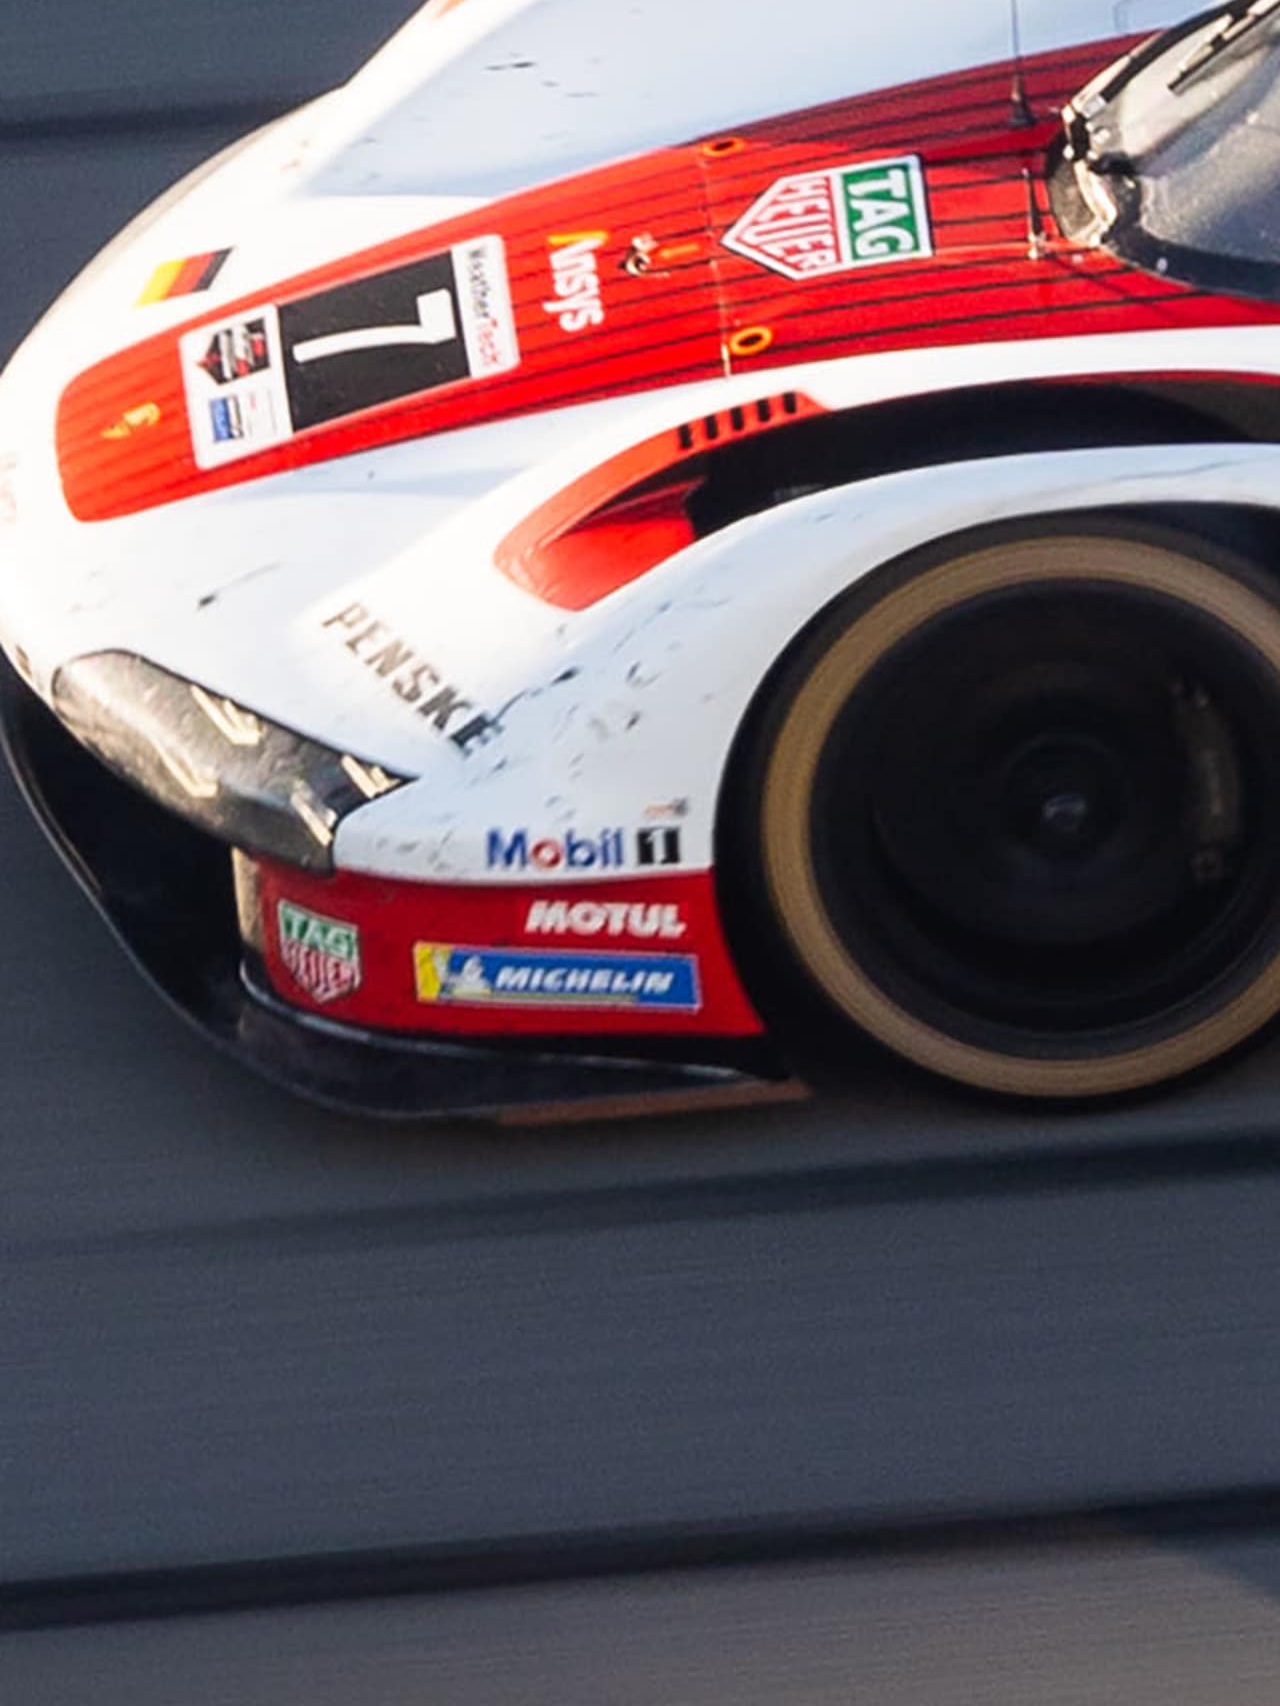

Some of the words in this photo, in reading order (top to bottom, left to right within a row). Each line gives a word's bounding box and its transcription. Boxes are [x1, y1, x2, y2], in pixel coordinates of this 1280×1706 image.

[735, 176, 836, 272] HEUER
[848, 167, 916, 257] TAG
[547, 231, 608, 332] Ansys
[292, 288, 456, 363] 7
[321, 601, 502, 759] PENSKE
[485, 826, 624, 869] Mobil
[284, 904, 357, 958] TAG
[525, 900, 687, 938] MOTUL
[496, 966, 674, 995] MICHELIN
